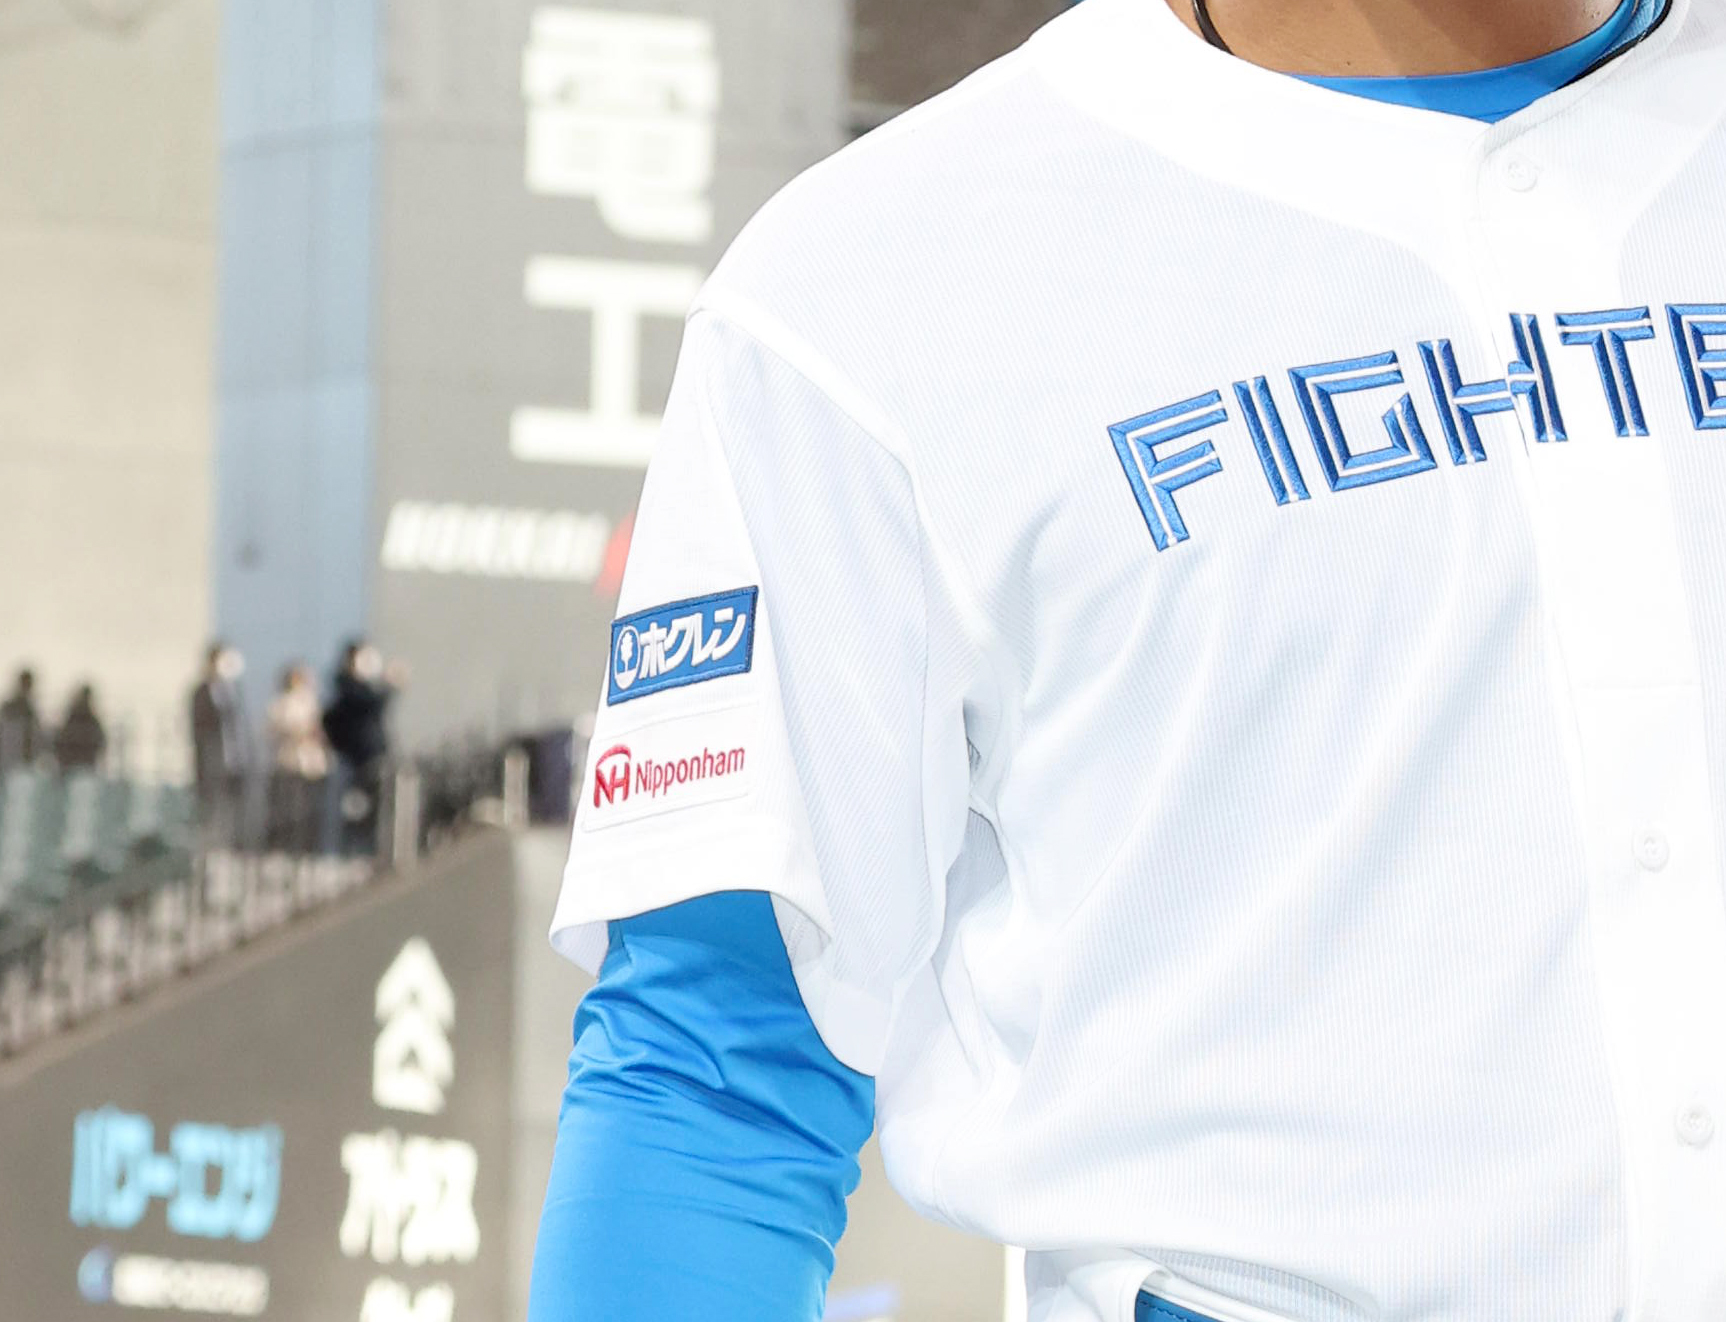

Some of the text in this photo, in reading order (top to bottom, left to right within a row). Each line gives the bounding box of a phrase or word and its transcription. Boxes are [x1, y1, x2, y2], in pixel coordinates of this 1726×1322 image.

[639, 607, 747, 680] ホクレン
[635, 747, 745, 798] Nipponham
